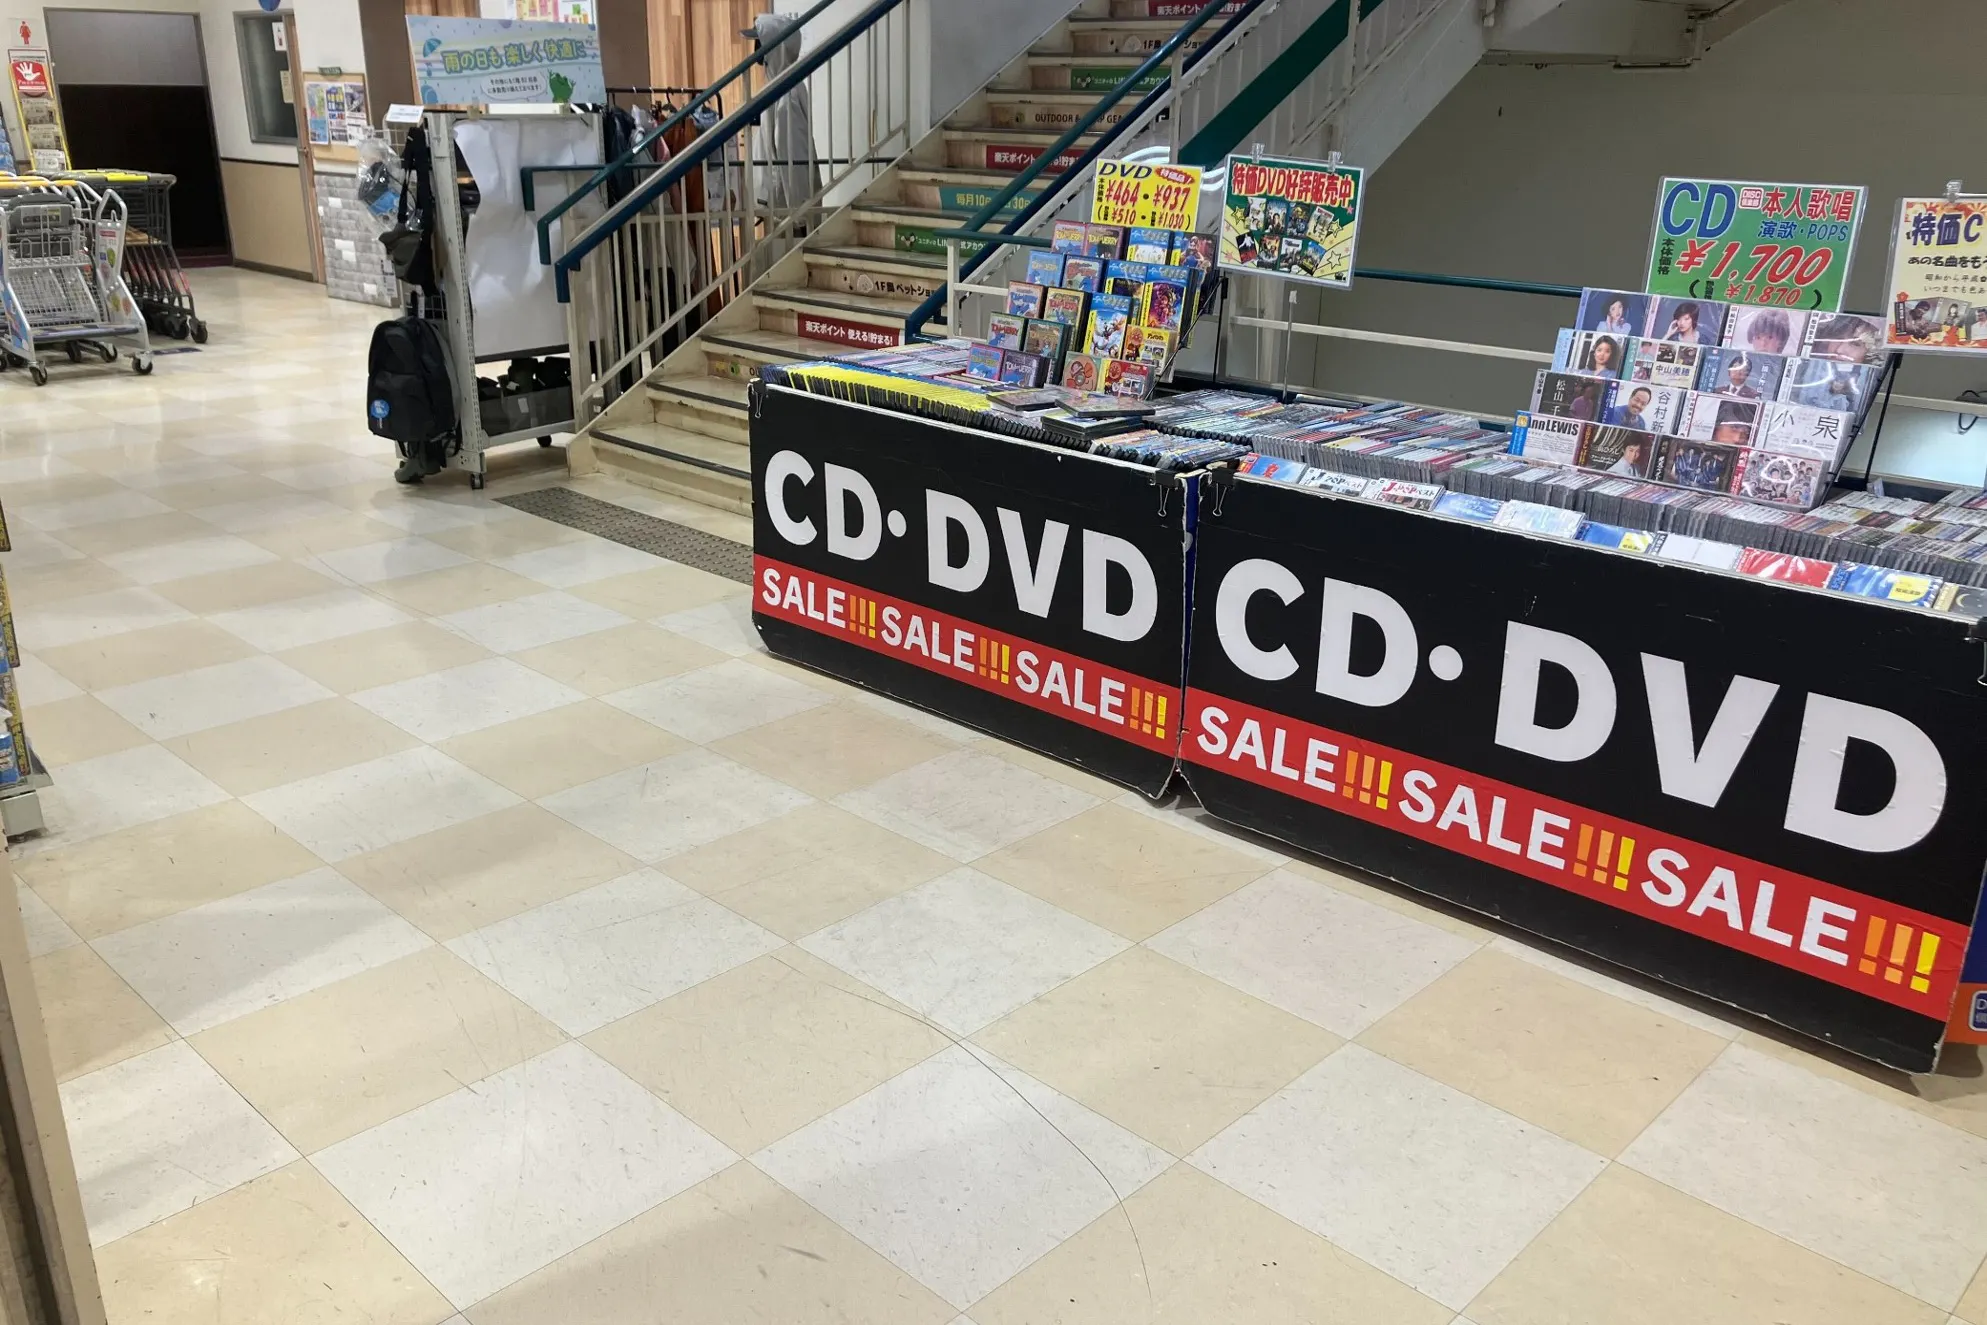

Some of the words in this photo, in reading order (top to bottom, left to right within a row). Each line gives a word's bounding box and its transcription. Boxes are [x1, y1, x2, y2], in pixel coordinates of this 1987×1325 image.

[442, 47, 503, 74] 雨の日も
[504, 41, 543, 68] 楽しく
[543, 38, 587, 61] 快適に
[1035, 113, 1074, 123] OUTDOOR
[994, 152, 1036, 165] 楽天ポイント
[1099, 162, 1153, 178] DVD
[1105, 180, 1140, 207] ¥464
[1153, 184, 1191, 211] ¥937
[1232, 163, 1355, 208] 特価DVD好評販売中
[1743, 190, 1762, 199] DISC
[1112, 207, 1137, 225] ¥510
[1662, 182, 1737, 239] CD
[1761, 187, 1856, 222] 本人歌唱
[1758, 220, 1849, 241] 演歌・POPS
[1657, 238, 1675, 275] 本体価格
[1675, 239, 1833, 287] ¥1,700
[1724, 283, 1802, 307] ¥1,870
[805, 320, 846, 338] 楽天ポイント
[847, 328, 893, 346] 使える!貯まる!
[1651, 391, 1671, 433] 谷村新
[1774, 410, 1795, 428] 小
[1812, 415, 1840, 440] 泉
[1545, 420, 1579, 437] LEWIS
[762, 568, 876, 639] SALE!!!
[881, 606, 1010, 684] SALE!!!
[1015, 651, 1168, 739] SALE!!!
[1197, 706, 1393, 810] SALE!!!
[1399, 769, 1635, 891] SALE!!!
[1640, 848, 1940, 993] SALE!!!
